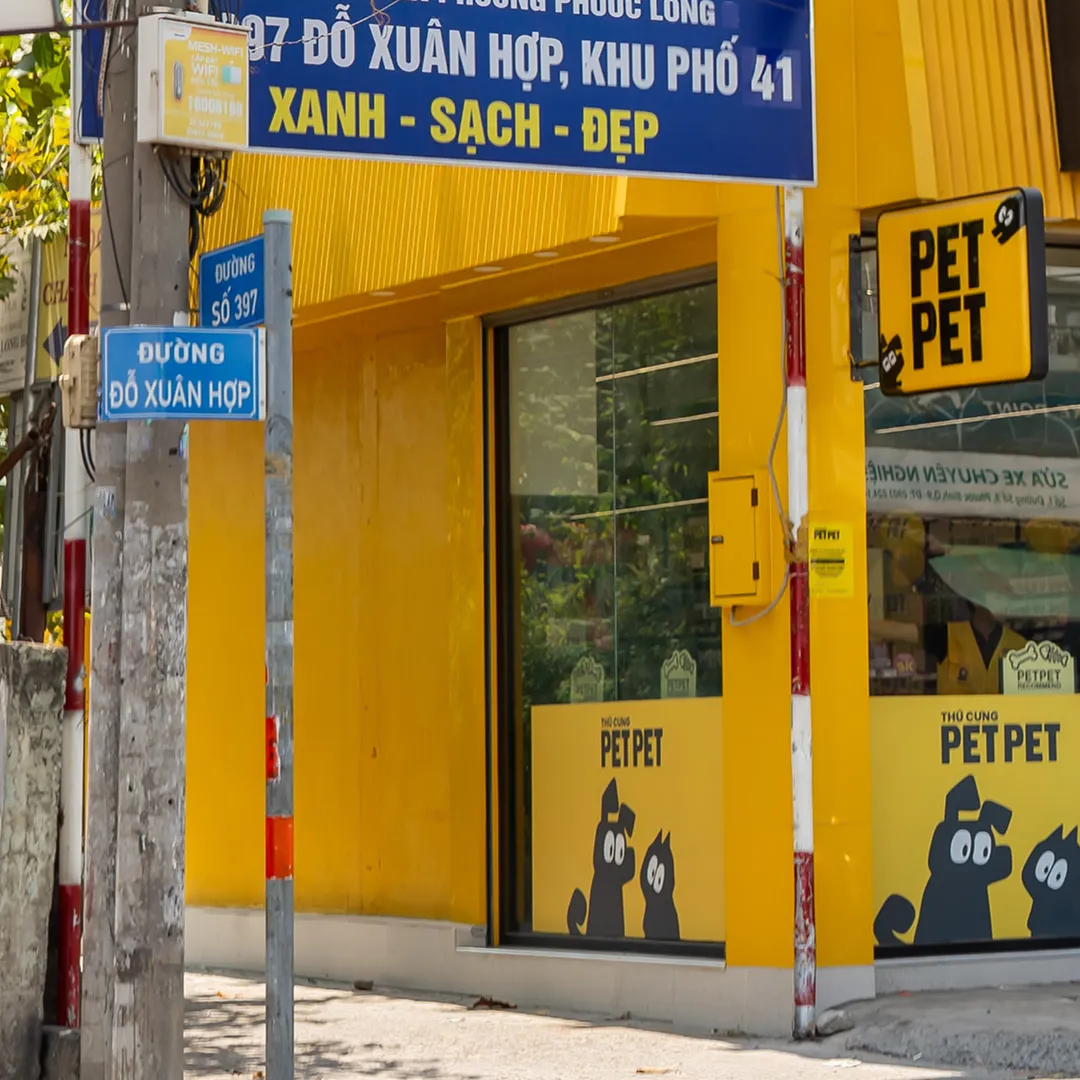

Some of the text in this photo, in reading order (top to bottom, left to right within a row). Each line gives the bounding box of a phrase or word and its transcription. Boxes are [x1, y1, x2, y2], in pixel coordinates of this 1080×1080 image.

[302, 3, 356, 67] ĐỖ
[369, 18, 476, 77] XUÂN
[488, 31, 569, 91] HỢP,
[581, 39, 655, 90] KHU
[667, 34, 739, 96] PHỐ
[750, 55, 793, 102] 41
[268, 85, 386, 139] XANH
[400, 115, 415, 126] -
[430, 97, 541, 155] SẠCH
[554, 125, 569, 136] -
[581, 106, 660, 164] ĐẸP
[214, 250, 255, 287] ĐƯỜNG
[909, 218, 985, 298] PET
[211, 288, 258, 327] SỐ 397
[137, 337, 225, 365] ĐƯỜNG
[911, 293, 986, 370] PET
[109, 369, 251, 413] ĐỖ XUÂN HỢP
[601, 728, 663, 768] PET PET
[941, 723, 1061, 764] PET PET
